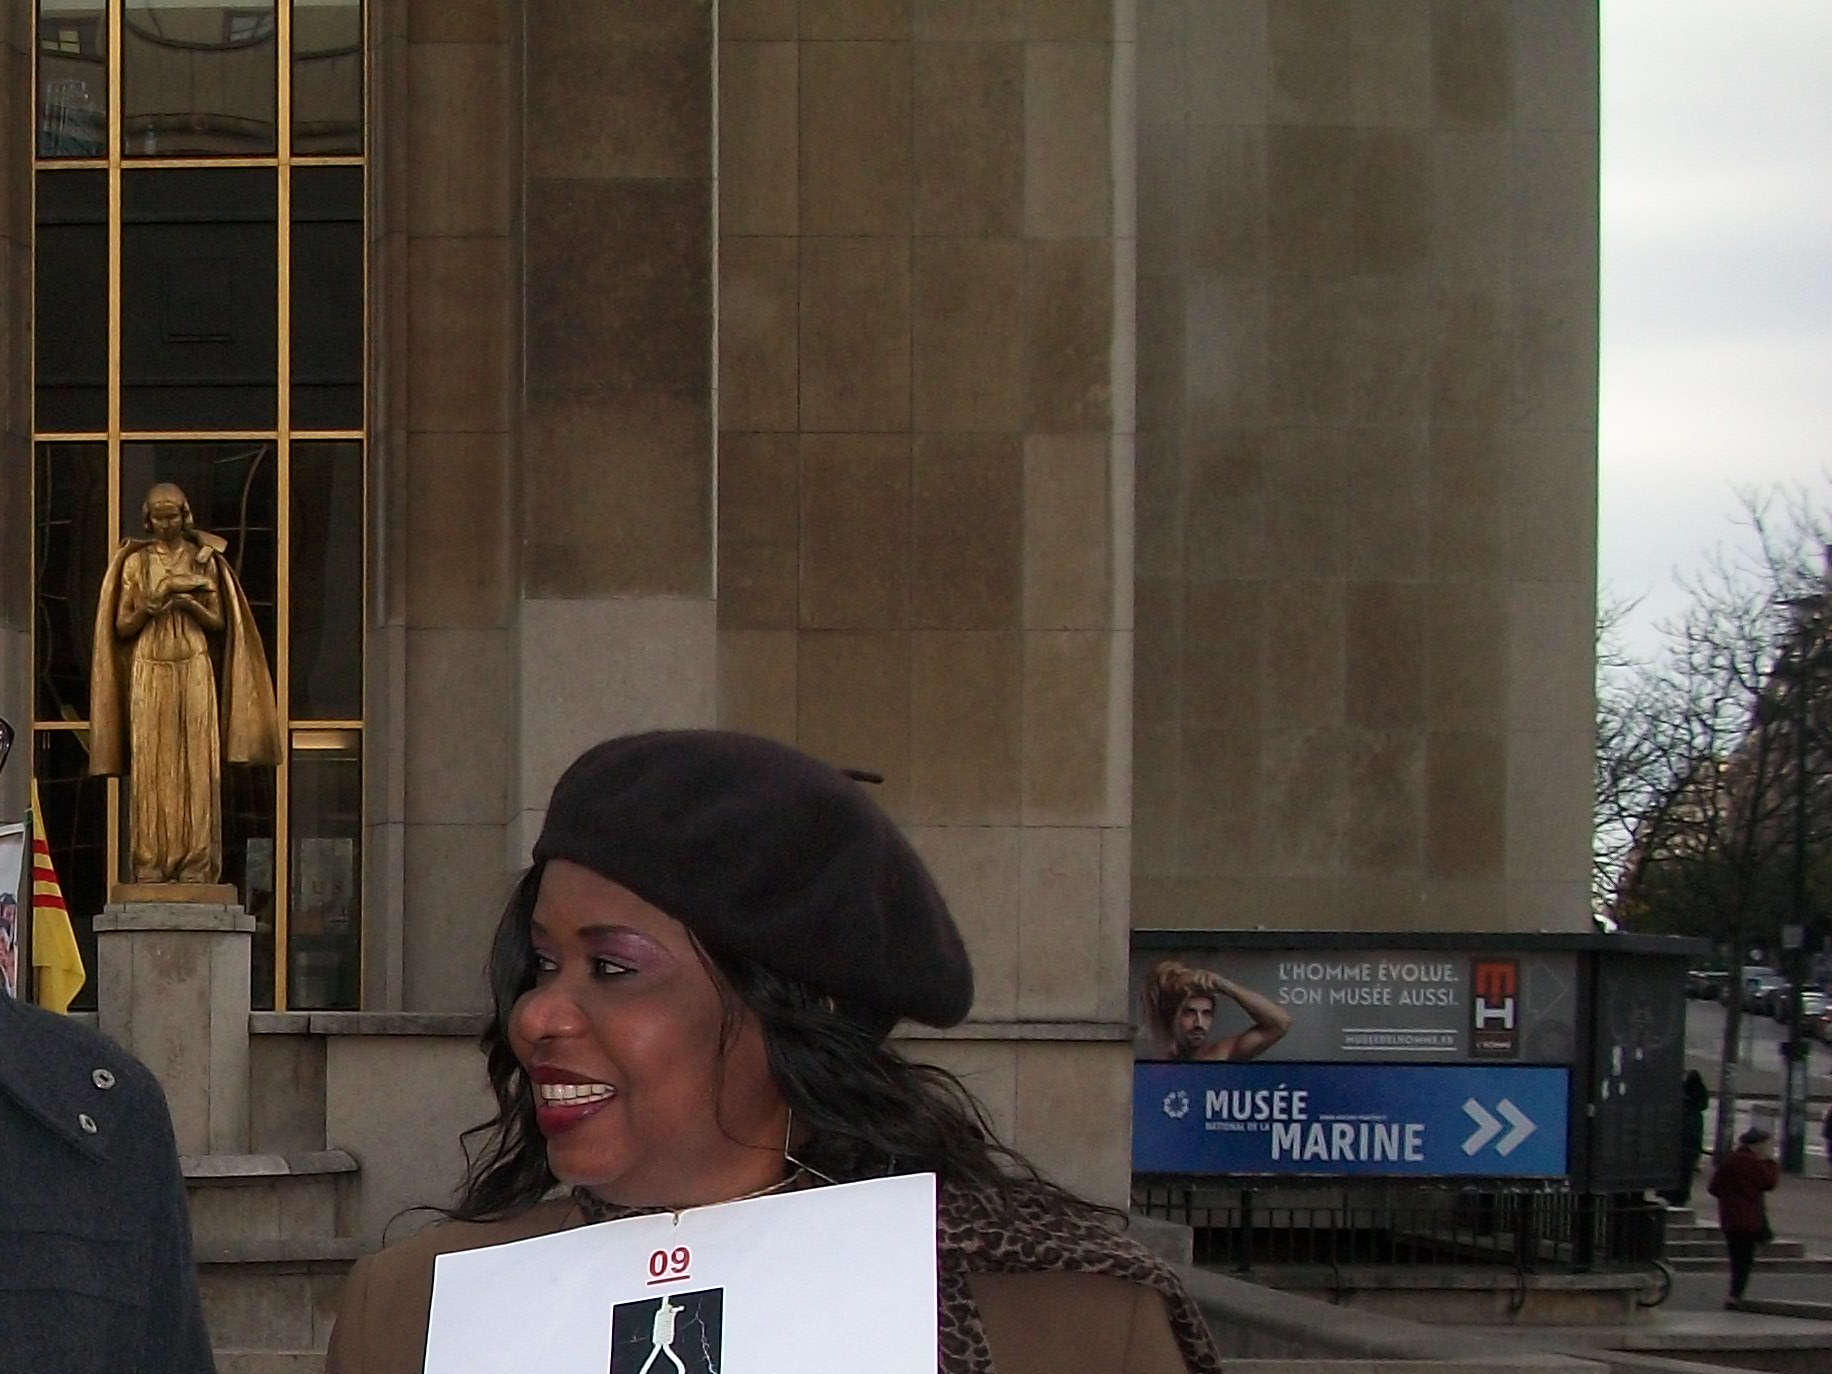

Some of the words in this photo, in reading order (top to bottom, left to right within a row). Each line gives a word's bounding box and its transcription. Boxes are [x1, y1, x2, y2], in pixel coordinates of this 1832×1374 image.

[1278, 963, 1371, 982] L'HOMME
[1378, 959, 1459, 982] ÉVOLUE.
[1278, 987, 1322, 1006] SON
[1330, 983, 1393, 1006] MUSÉE
[1399, 987, 1459, 1007] AUSSI.
[1205, 1083, 1309, 1120] MUSÉE
[1271, 1122, 1426, 1162] MARINE
[648, 1246, 692, 1284] 09
